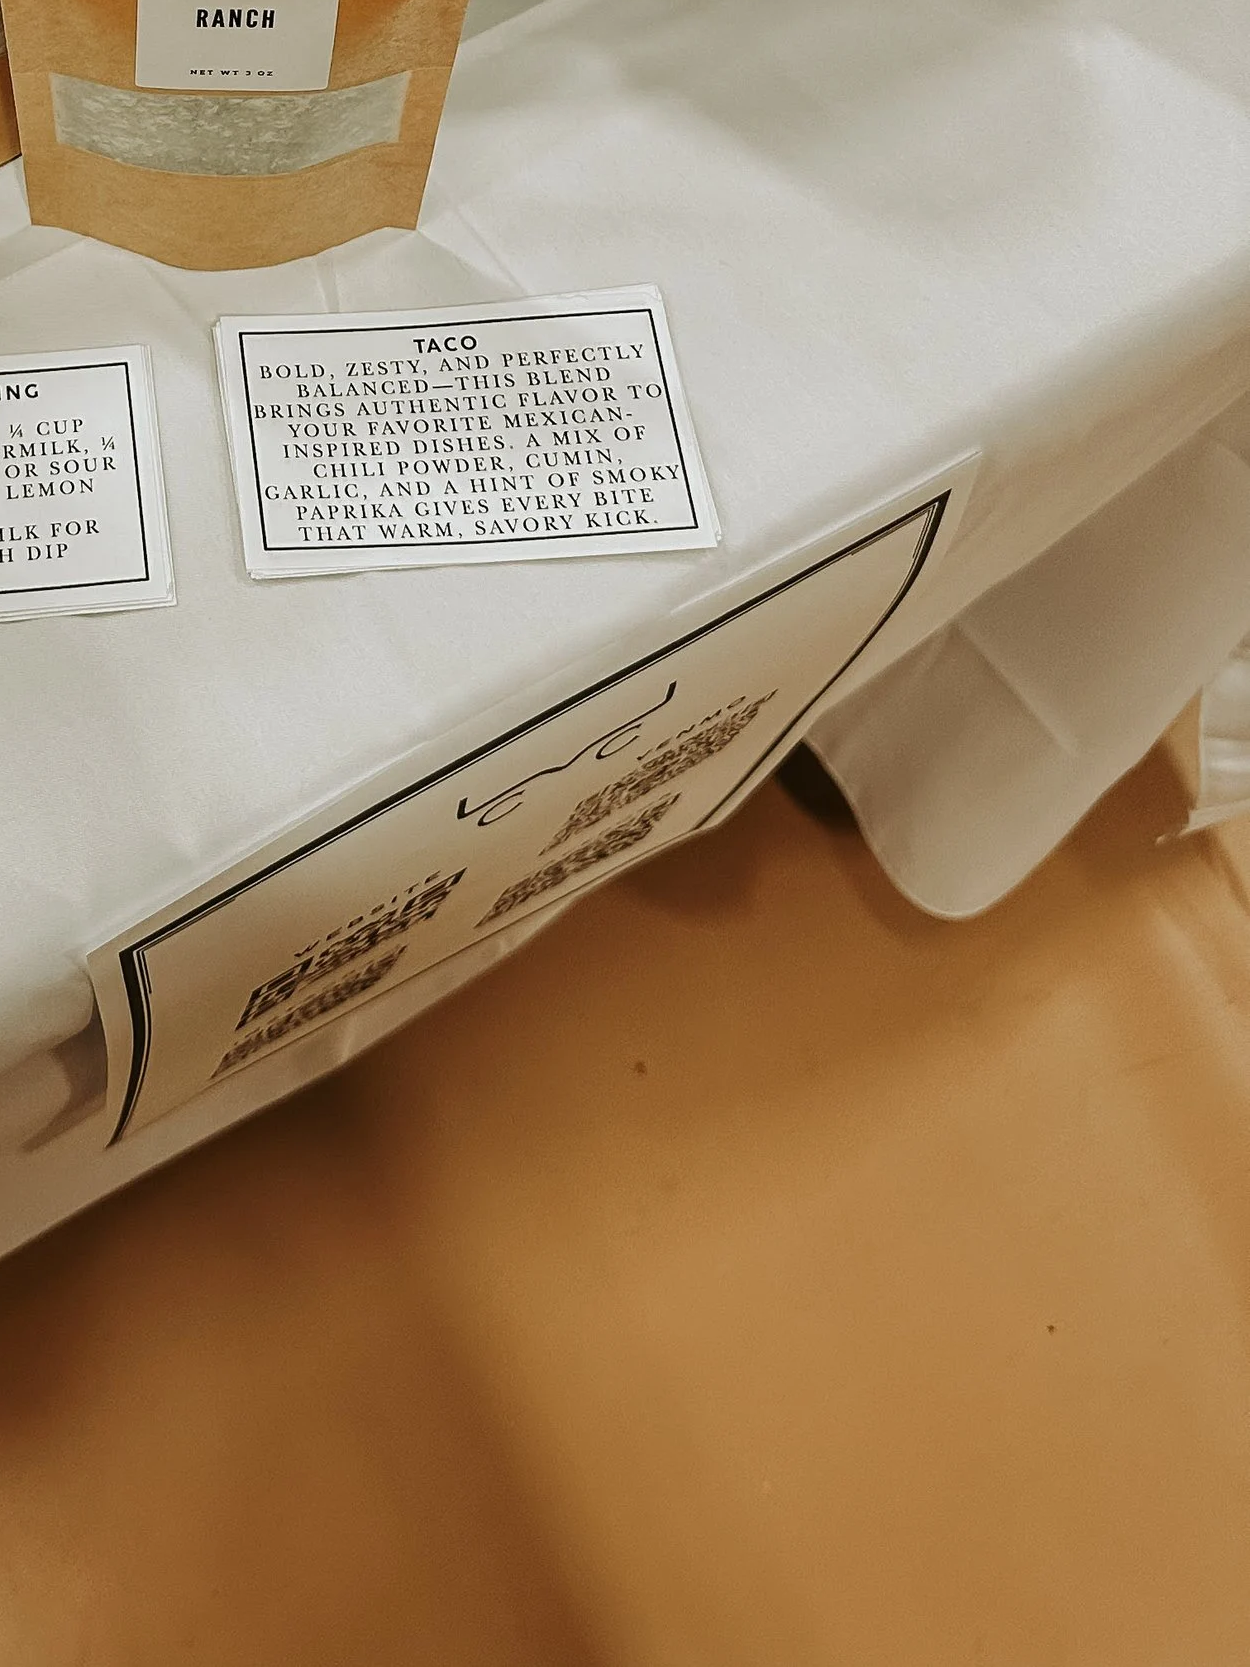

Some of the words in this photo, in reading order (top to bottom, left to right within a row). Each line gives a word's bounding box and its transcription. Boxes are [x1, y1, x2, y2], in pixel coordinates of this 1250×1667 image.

[196, 9, 275, 28] RANCH
[413, 336, 478, 354] TACO
[259, 363, 334, 380] BOLD,
[346, 359, 429, 377] ZESTY,
[439, 355, 490, 372] AND
[502, 344, 645, 367] PERFECTLY
[297, 371, 515, 398] BALANCED—THIS
[528, 366, 611, 385] BLEND
[254, 402, 346, 420] BRINGS
[357, 393, 507, 416] AUTHENTIC
[518, 385, 616, 408] FLAVOR
[628, 384, 663, 399] TO
[36, 418, 85, 436] CUP
[287, 422, 355, 438] YOUR
[367, 415, 492, 435] FAVORITE
[504, 406, 633, 429] MEXICAN-
[283, 440, 401, 459] INSPIRED
[413, 436, 514, 454] DISHES.
[526, 433, 543, 448] A
[553, 428, 602, 446] MIX
[614, 425, 646, 441] OF
[4, 462, 38, 479] OR
[49, 456, 118, 475] SOUR
[313, 462, 386, 480] CHILI
[398, 455, 514, 475] POWDER,
[525, 449, 623, 468] CUMIN,
[6, 478, 95, 500] LEMON
[264, 484, 368, 501] GARLIC,
[379, 479, 431, 496] AND
[443, 479, 459, 494] A
[470, 474, 534, 492] HINT
[548, 470, 581, 488] OF
[593, 464, 680, 485] SMOKY
[296, 503, 403, 521] PAPRIKA
[414, 498, 489, 517] GIVES
[502, 492, 581, 511] EVERY
[593, 487, 654, 505] BITE
[50, 520, 100, 539] FOR
[298, 524, 367, 542] THAT
[378, 521, 463, 540] WARM,
[475, 514, 573, 536] SAVORY
[585, 508, 658, 529] KICK.
[27, 544, 71, 561] DIP
